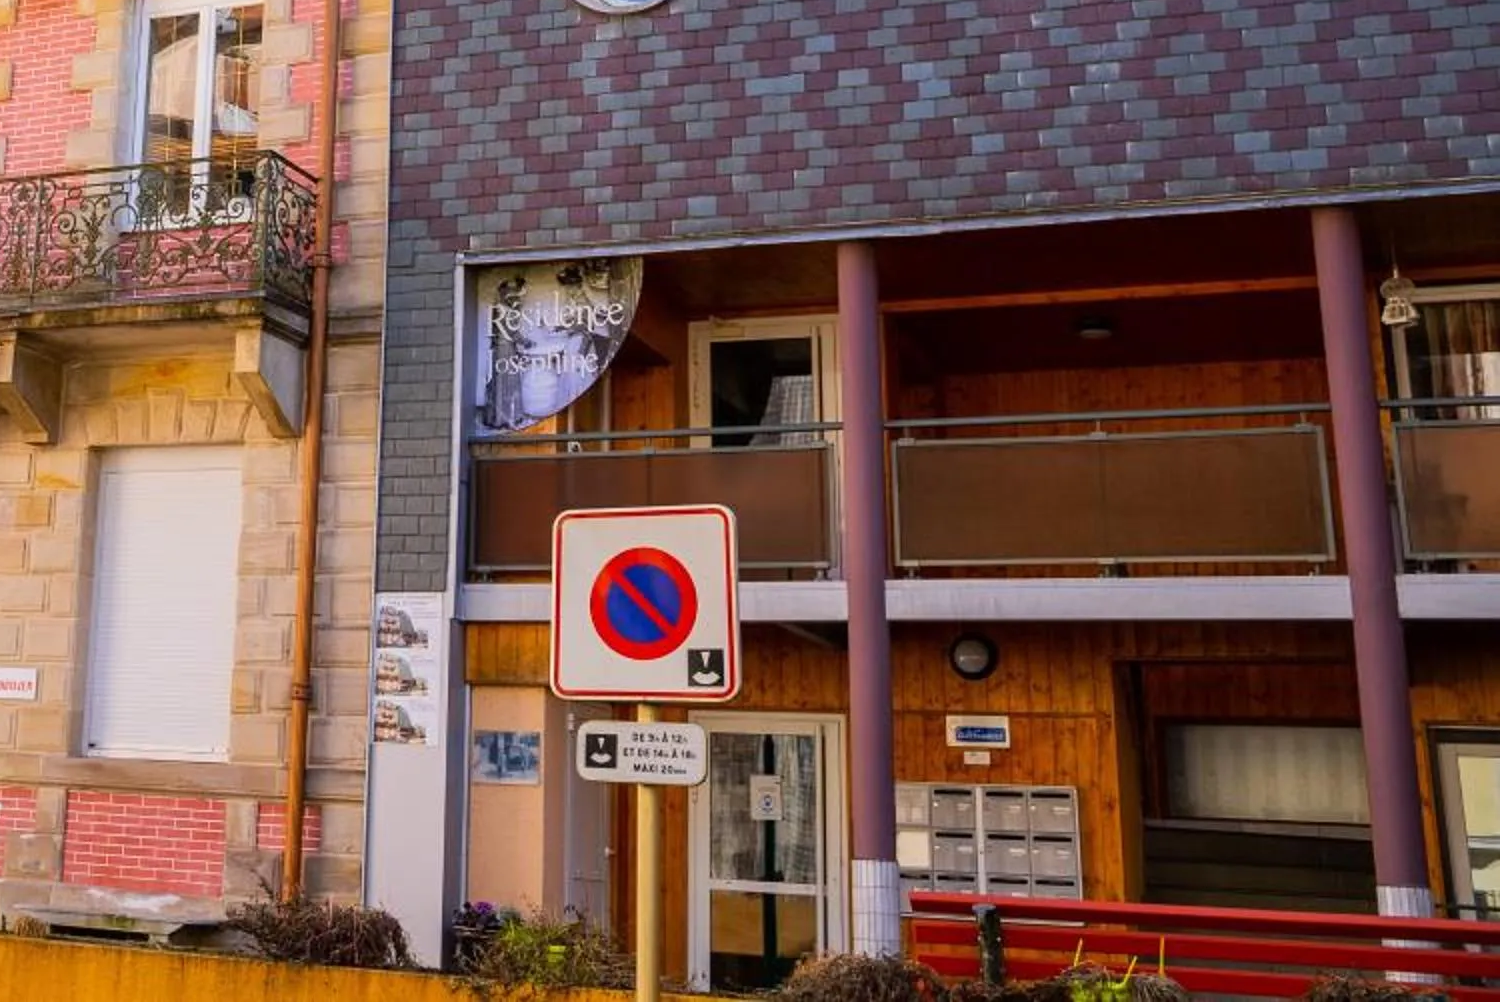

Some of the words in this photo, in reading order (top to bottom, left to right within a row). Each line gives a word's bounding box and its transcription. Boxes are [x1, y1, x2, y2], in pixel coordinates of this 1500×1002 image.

[487, 290, 625, 341] Résidence
[623, 747, 634, 757] ET
[633, 763, 658, 773] MAXI
